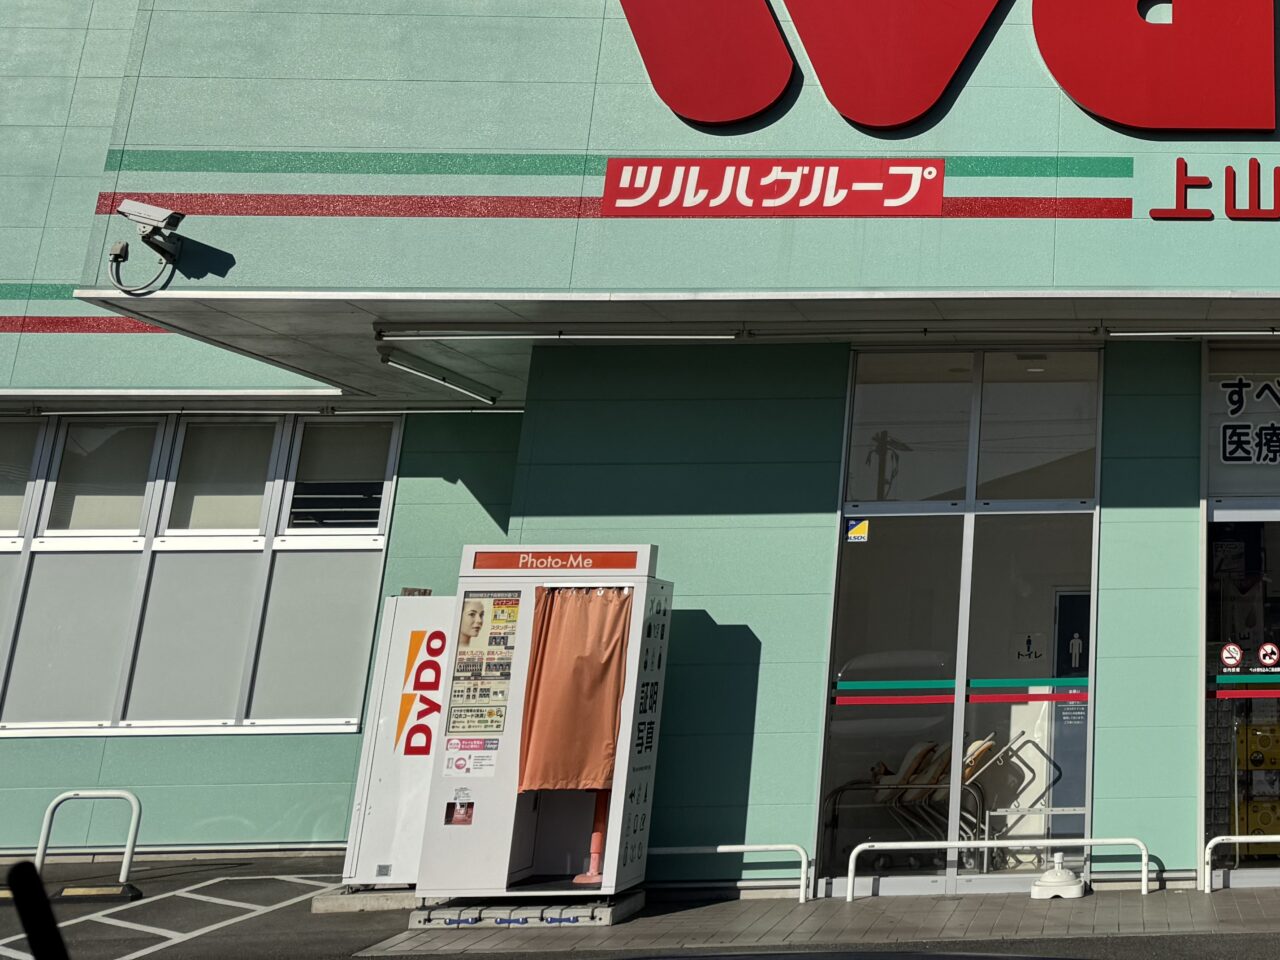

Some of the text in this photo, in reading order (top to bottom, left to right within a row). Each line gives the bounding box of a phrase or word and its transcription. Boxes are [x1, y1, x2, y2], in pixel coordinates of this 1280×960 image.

[615, 165, 938, 208] ツルハグループ
[518, 553, 593, 570] Photo-Me
[1017, 651, 1043, 660] トイレ
[404, 630, 447, 756] DyDo
